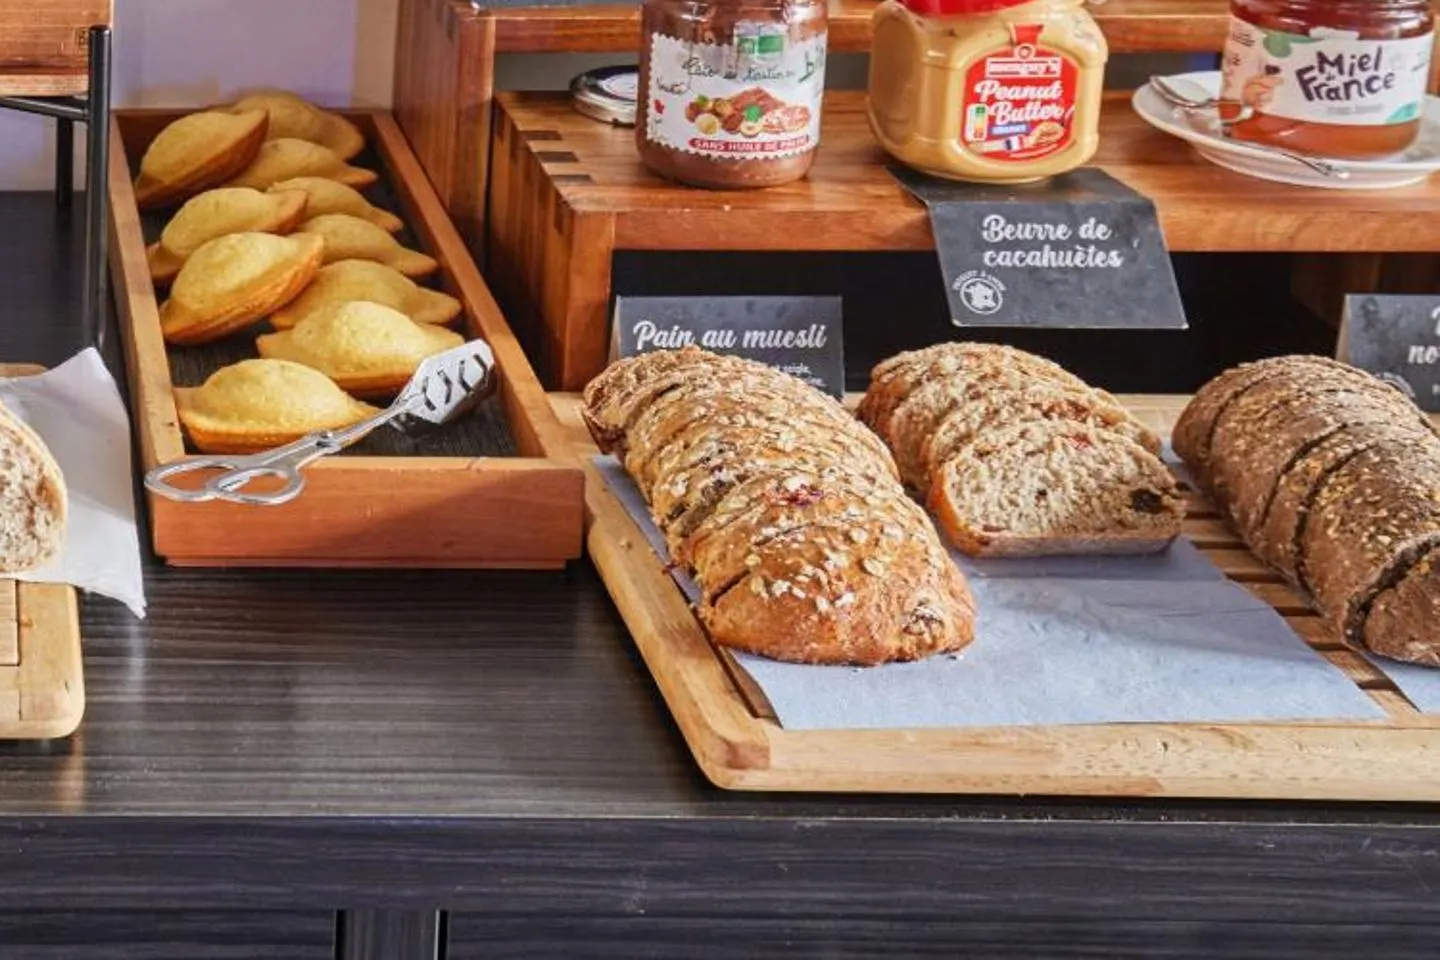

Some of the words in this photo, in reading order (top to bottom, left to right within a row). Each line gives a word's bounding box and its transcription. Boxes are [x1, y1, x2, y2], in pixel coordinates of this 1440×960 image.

[1316, 45, 1382, 77] Miel
[974, 80, 1064, 102] Peanut
[1295, 64, 1396, 102] France
[990, 100, 1065, 125] Butter
[694, 141, 725, 152] SANS
[729, 141, 761, 151] HUILE
[982, 214, 1072, 242] Beurre
[1078, 218, 1112, 241] de
[983, 244, 1124, 268] cacahuètes
[633, 320, 696, 351] Pain
[701, 330, 737, 349] au
[741, 324, 828, 349] muesli
